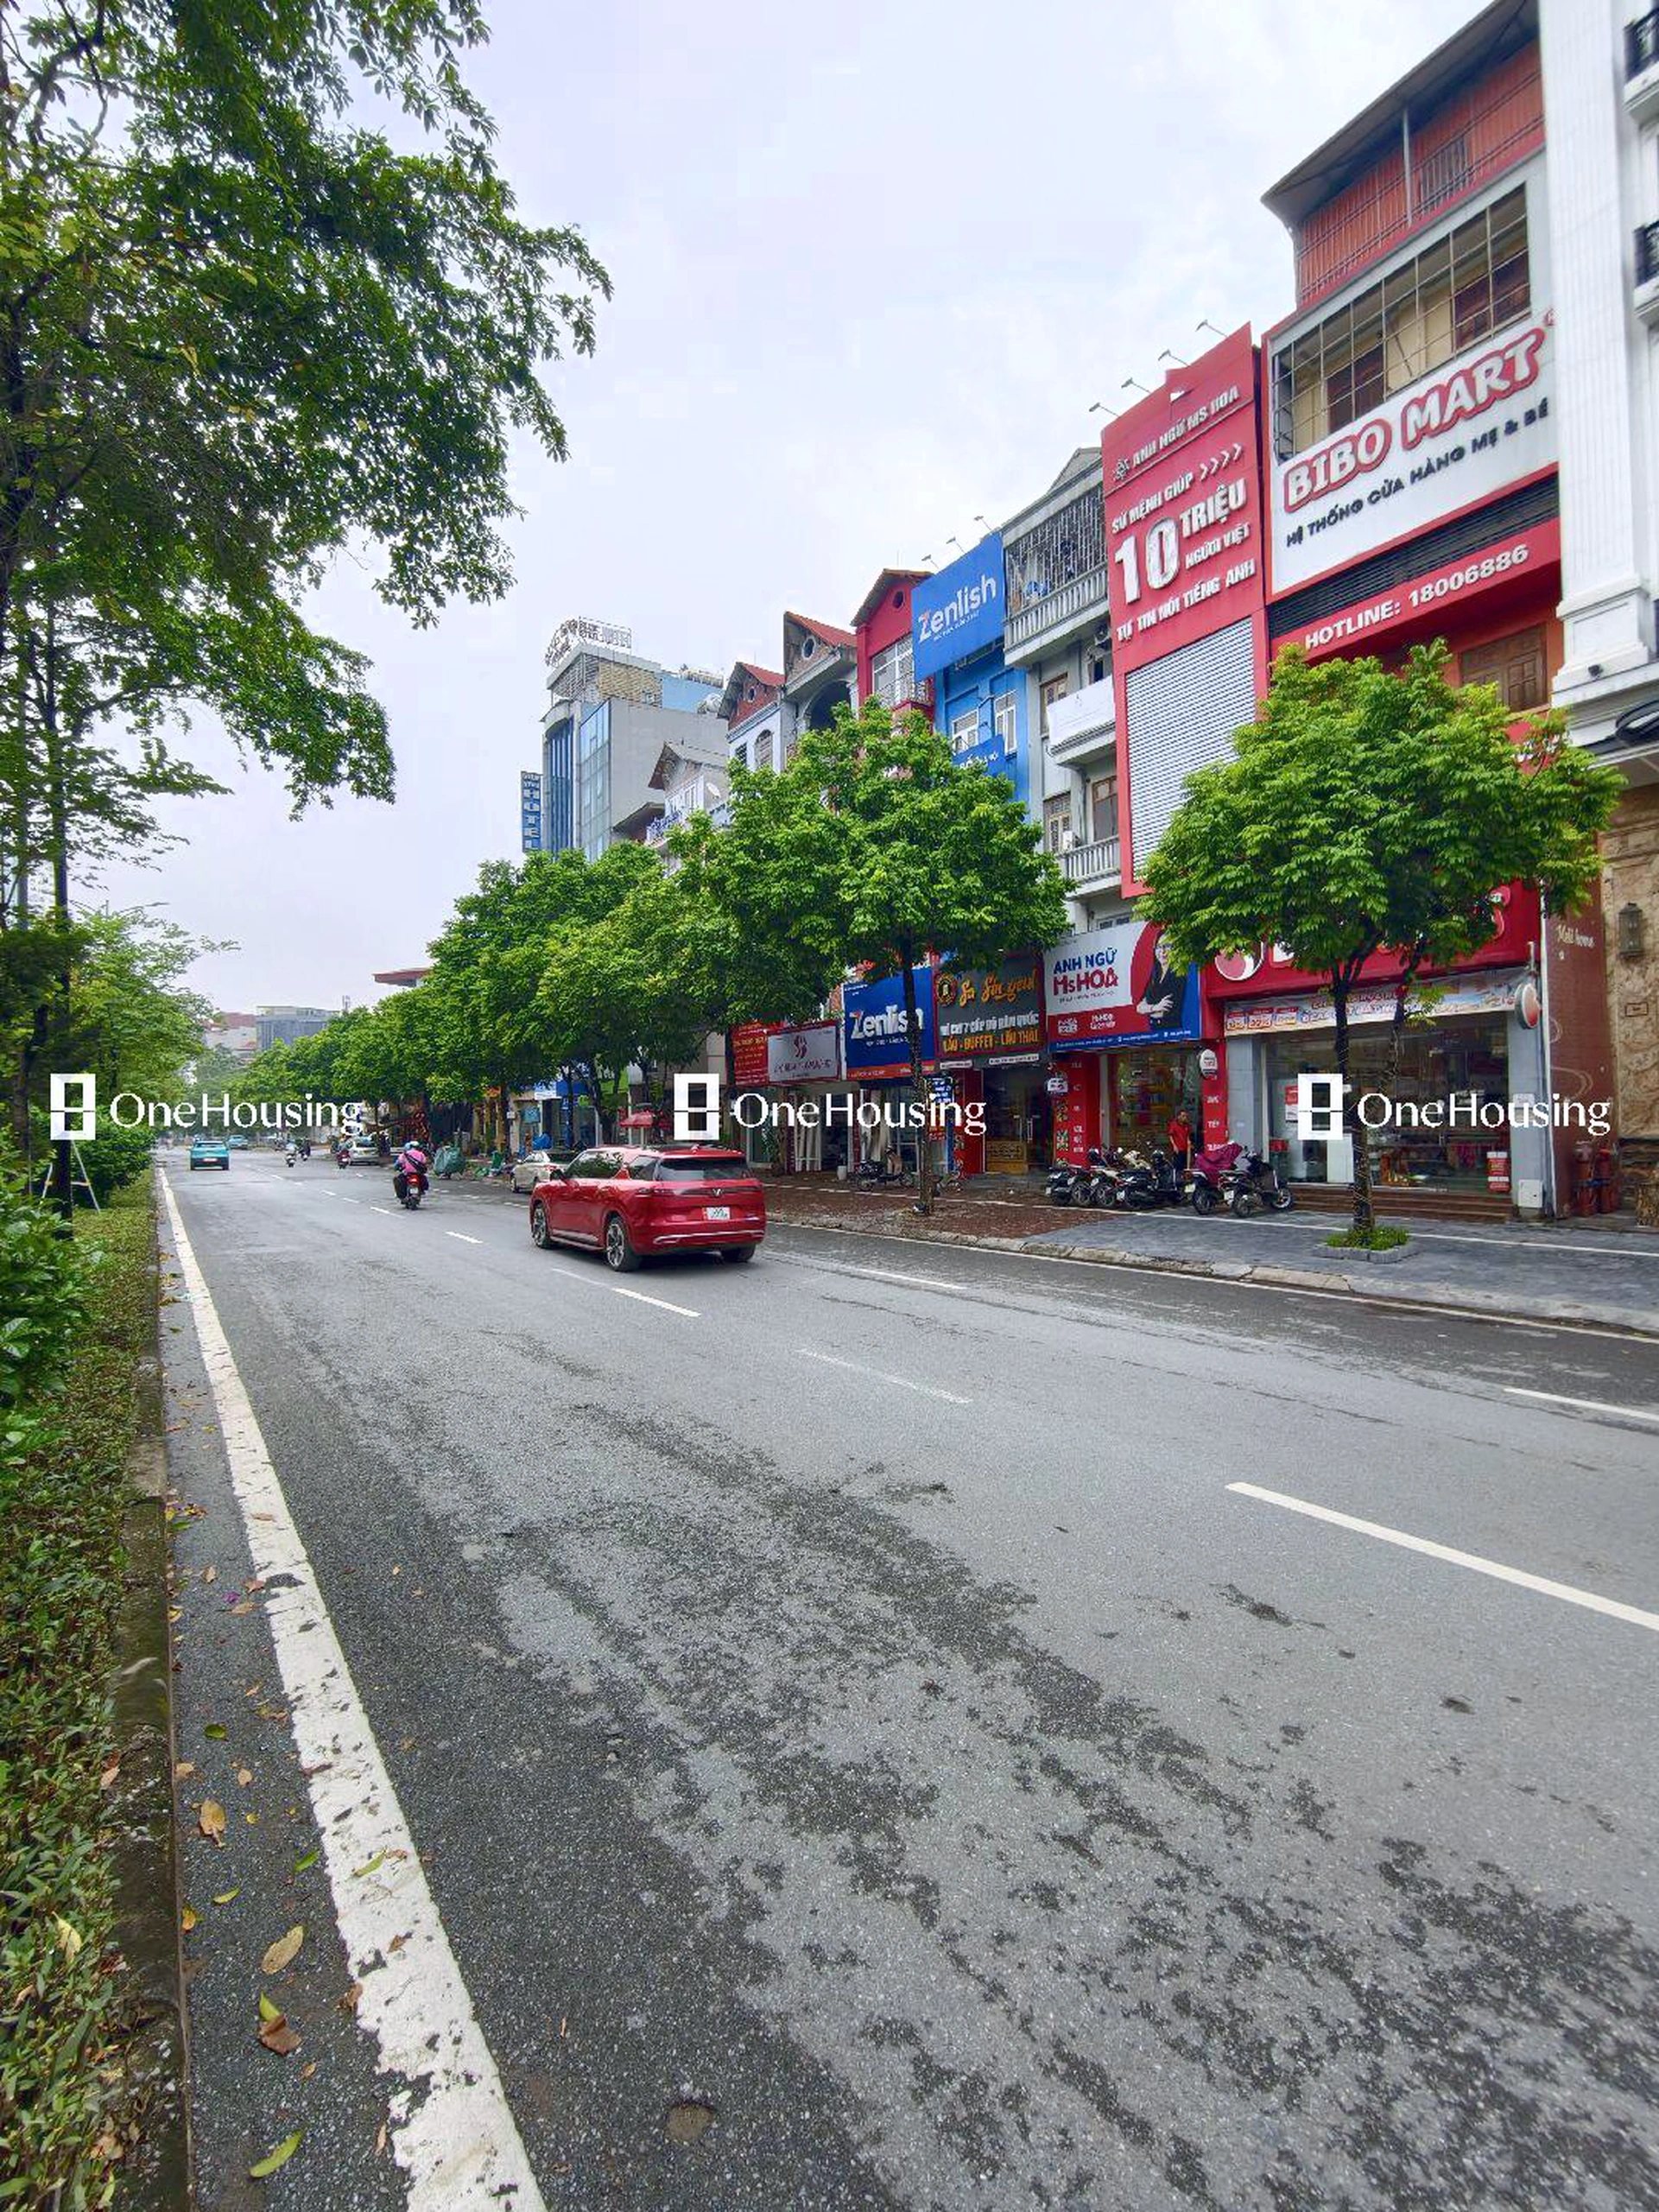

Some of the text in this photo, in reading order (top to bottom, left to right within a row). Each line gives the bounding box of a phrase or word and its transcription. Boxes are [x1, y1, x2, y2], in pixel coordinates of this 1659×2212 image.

[1283, 327, 1545, 512] BIBO MART
[1164, 472, 1194, 502] GIÚP
[1287, 396, 1549, 548] HỆ THỐNG CỬA HÀNG MẸ & BÉ
[1115, 478, 1247, 605] 10 TRIỆU
[918, 574, 997, 644] Zenlish
[1137, 610, 1157, 632] TIN
[1182, 576, 1221, 608] TIẾNG
[1225, 558, 1257, 589] ANH
[1305, 543, 1529, 650] HOTLINE: 18006886
[1053, 947, 1118, 975] ANH NGỮ
